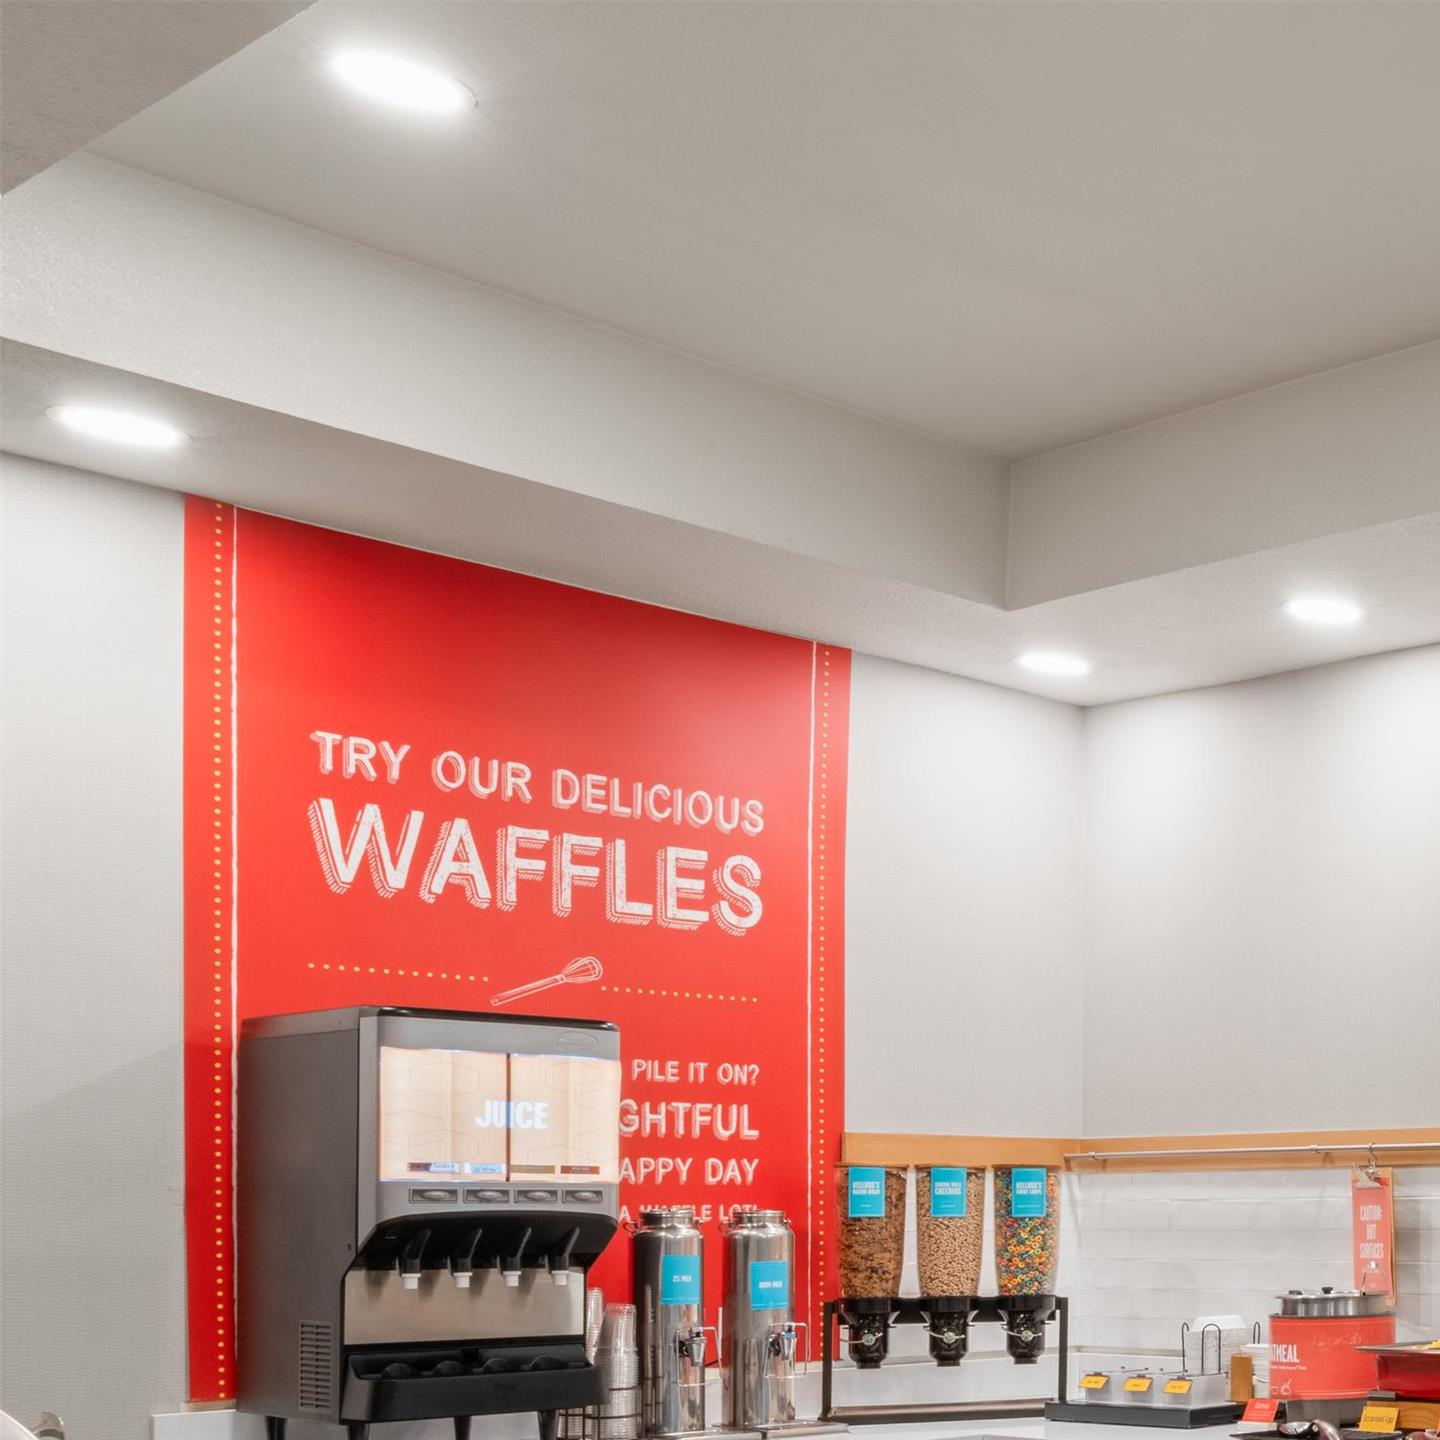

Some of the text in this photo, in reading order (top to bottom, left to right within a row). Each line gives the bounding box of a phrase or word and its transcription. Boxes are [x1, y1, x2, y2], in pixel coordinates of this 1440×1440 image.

[310, 730, 765, 835] TRY OUR DELICIOUS
[307, 797, 763, 937] WAFFLES
[632, 1059, 760, 1086] PILE IT ON?
[475, 1100, 549, 1129] JUICE
[619, 1099, 760, 1141] GHTFUL
[619, 1157, 760, 1185] APPY DAY
[1269, 1344, 1300, 1362] TMEAL
